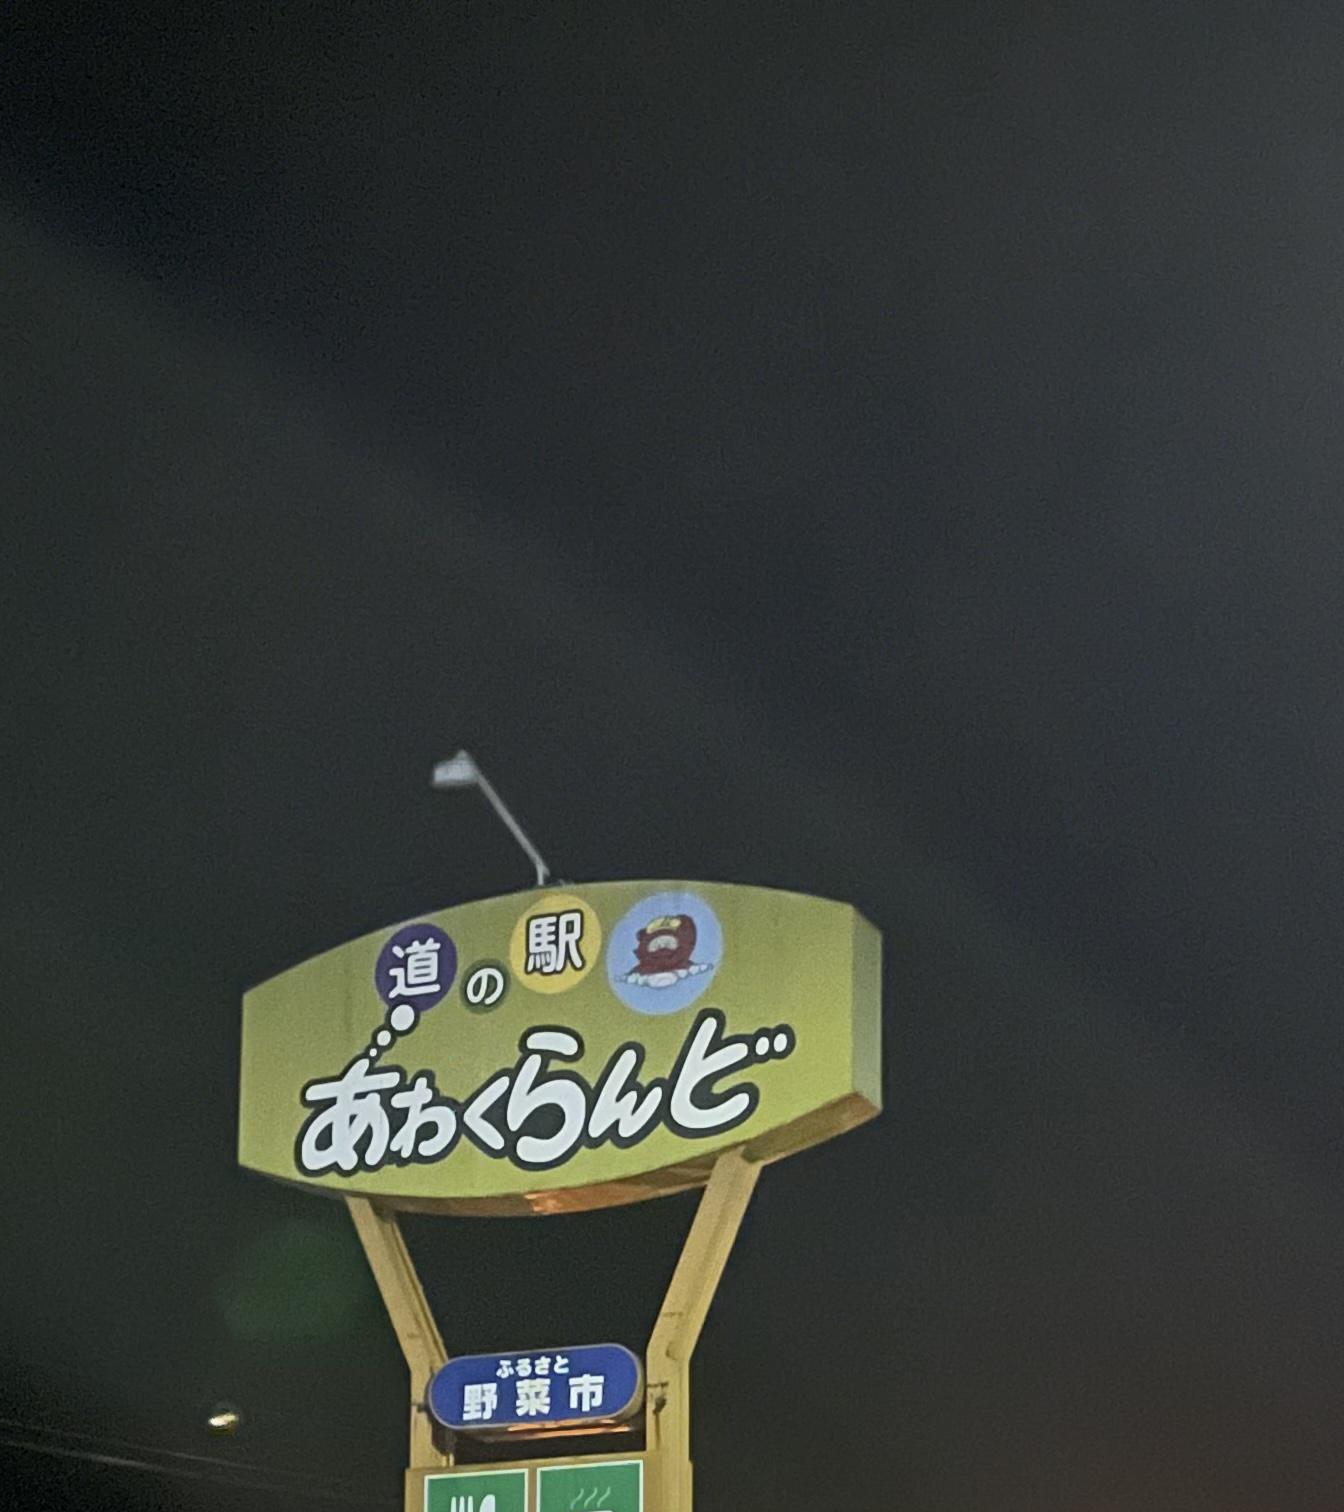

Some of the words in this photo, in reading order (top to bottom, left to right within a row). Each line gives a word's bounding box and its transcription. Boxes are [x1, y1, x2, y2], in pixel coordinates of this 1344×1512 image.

[387, 912, 583, 1005] 道の駅
[300, 1016, 788, 1171] あわくらんど
[462, 1374, 605, 1421] 野菜市
[495, 1355, 570, 1377] ふるさと
